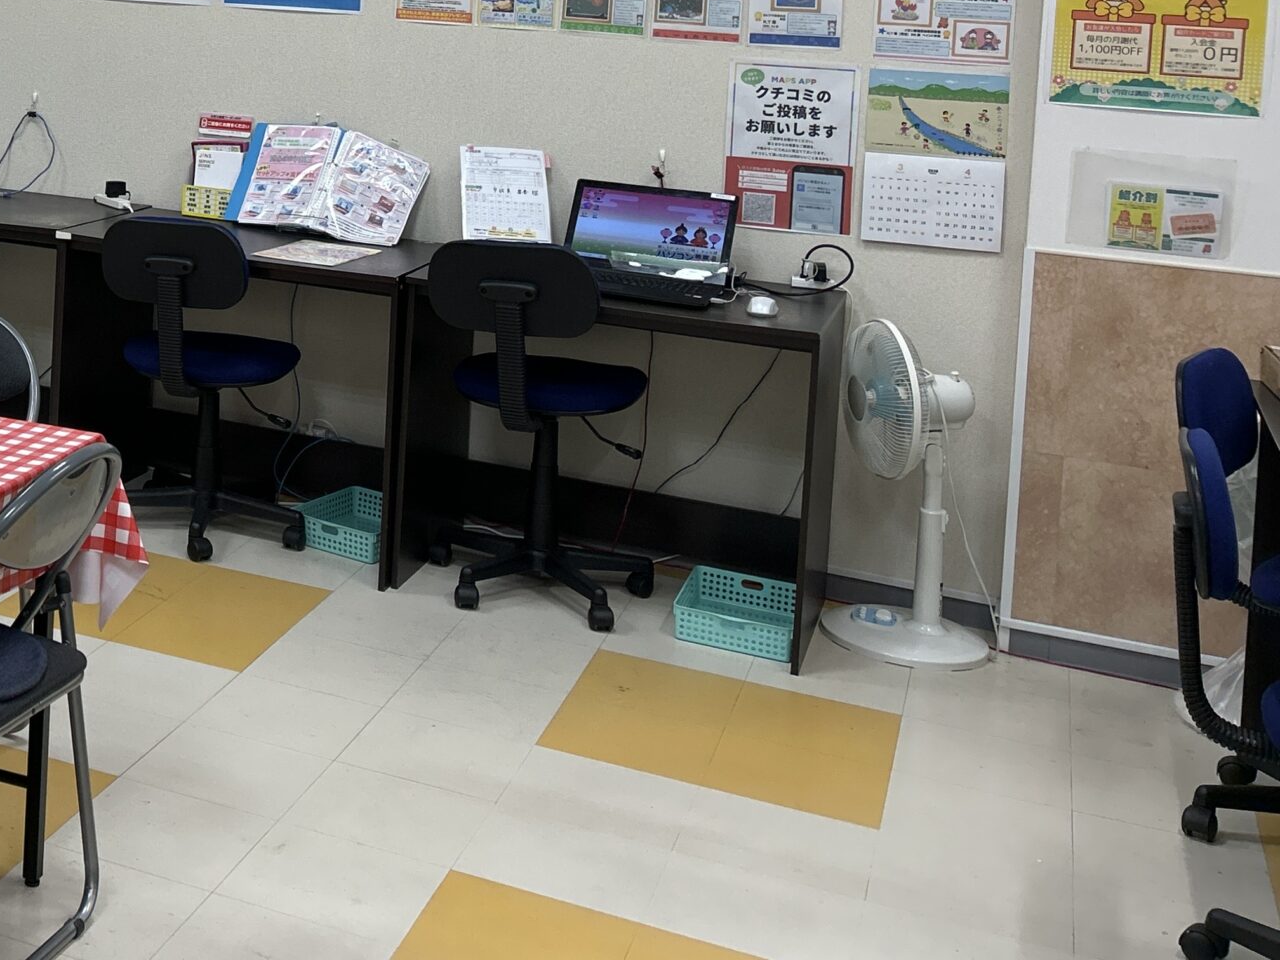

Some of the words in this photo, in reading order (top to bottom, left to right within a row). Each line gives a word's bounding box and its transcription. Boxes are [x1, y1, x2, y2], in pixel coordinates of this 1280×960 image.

[1078, 44, 1144, 56] 1,100円OFF
[1190, 38, 1217, 47] 入会金
[1203, 47, 1239, 62] 0円
[771, 76, 796, 84] MAPS
[756, 85, 831, 103] クチコミの
[762, 103, 822, 120] ご投稿を
[745, 118, 838, 139] お願いします
[1118, 189, 1158, 204] 紹介割
